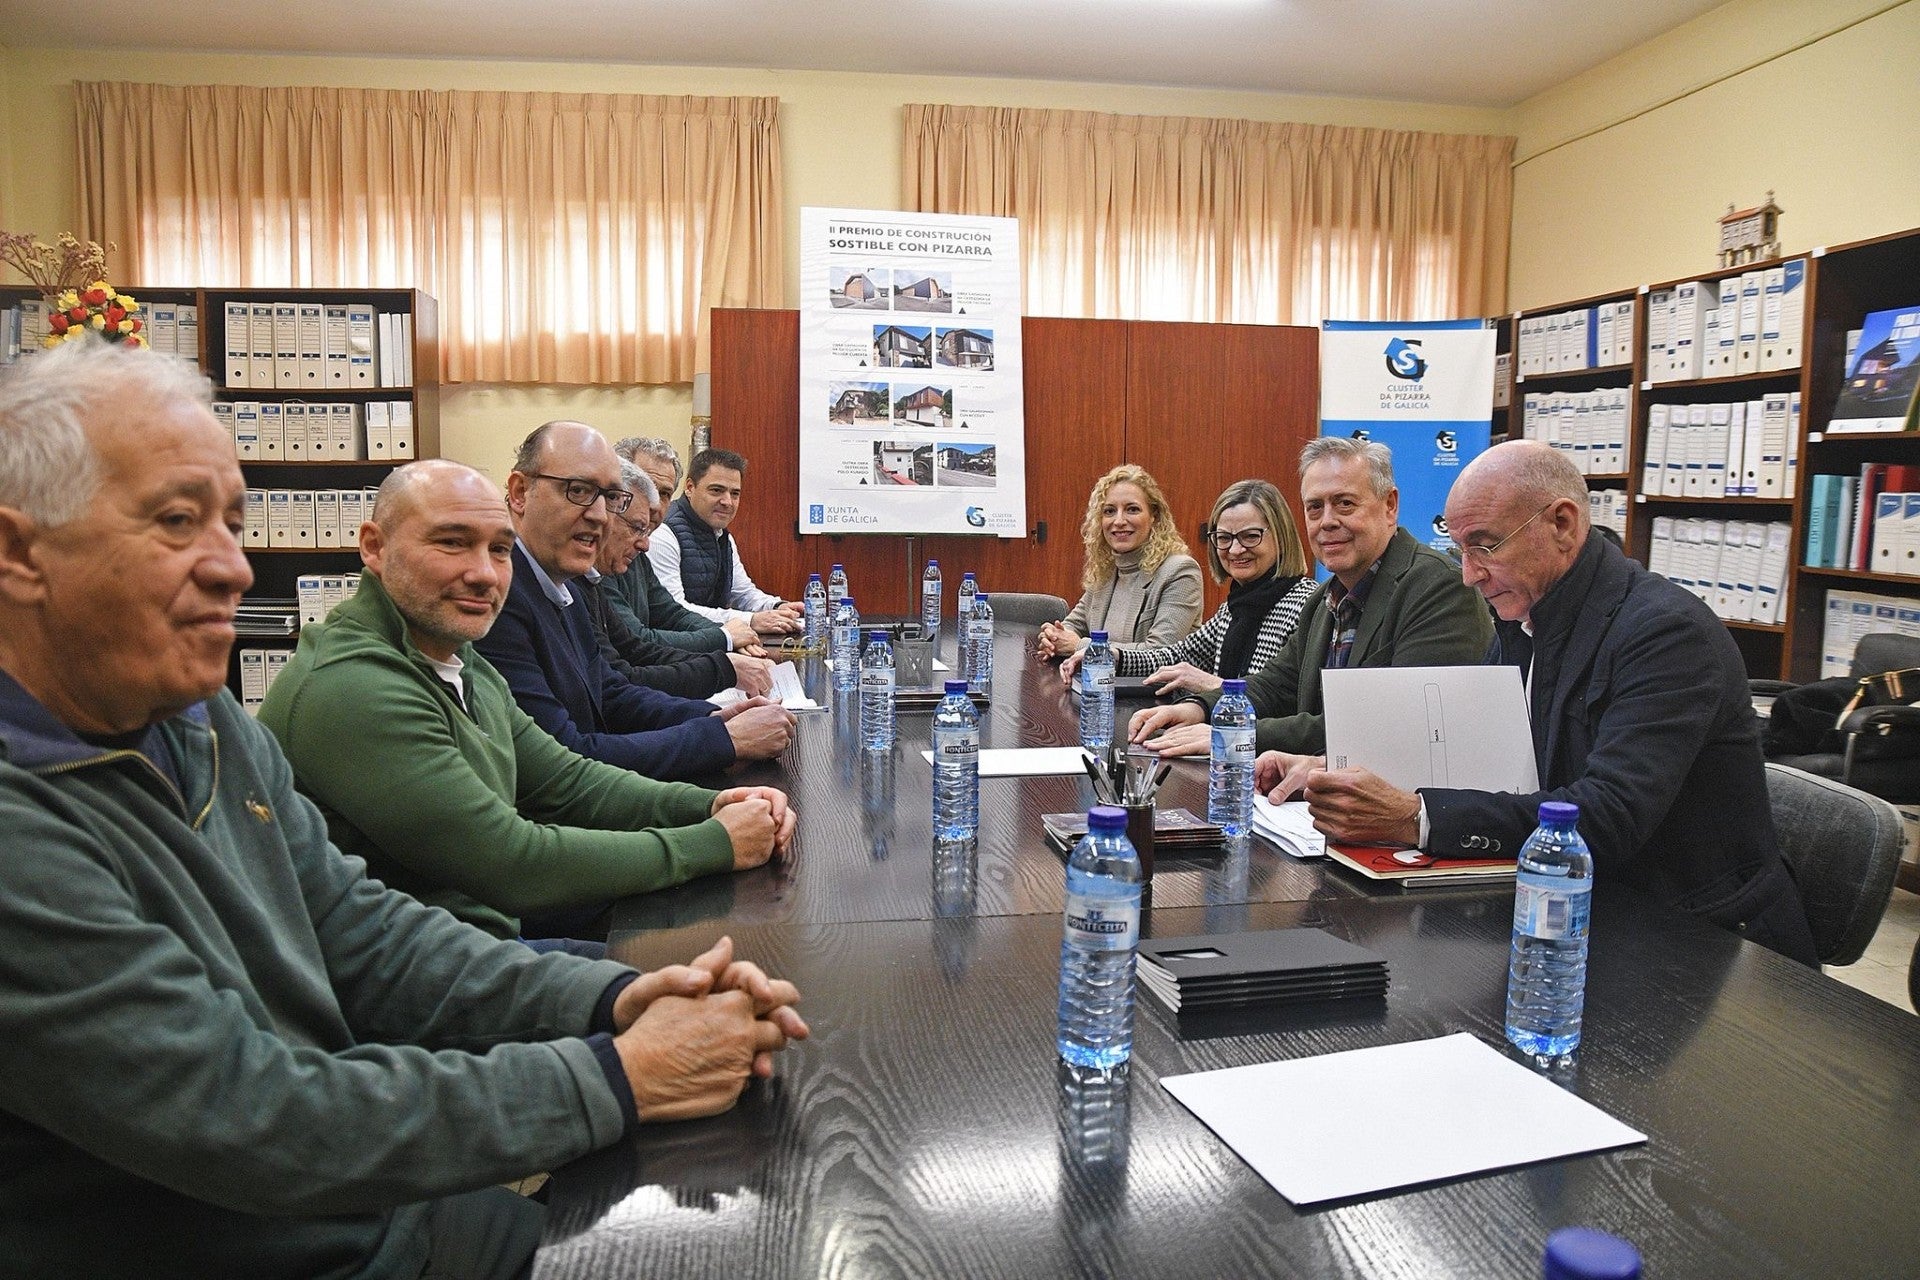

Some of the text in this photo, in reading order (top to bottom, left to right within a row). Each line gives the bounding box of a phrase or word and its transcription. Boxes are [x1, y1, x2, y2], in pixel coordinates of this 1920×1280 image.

[829, 226, 992, 242] II PREMIO DE CONSTRUCIÓN
[829, 239, 993, 256] SOSTIBLE CON PIZARRA
[1386, 384, 1424, 392] CLUSTER
[827, 506, 859, 514] XUNTA
[826, 515, 878, 524] DE GALICIA
